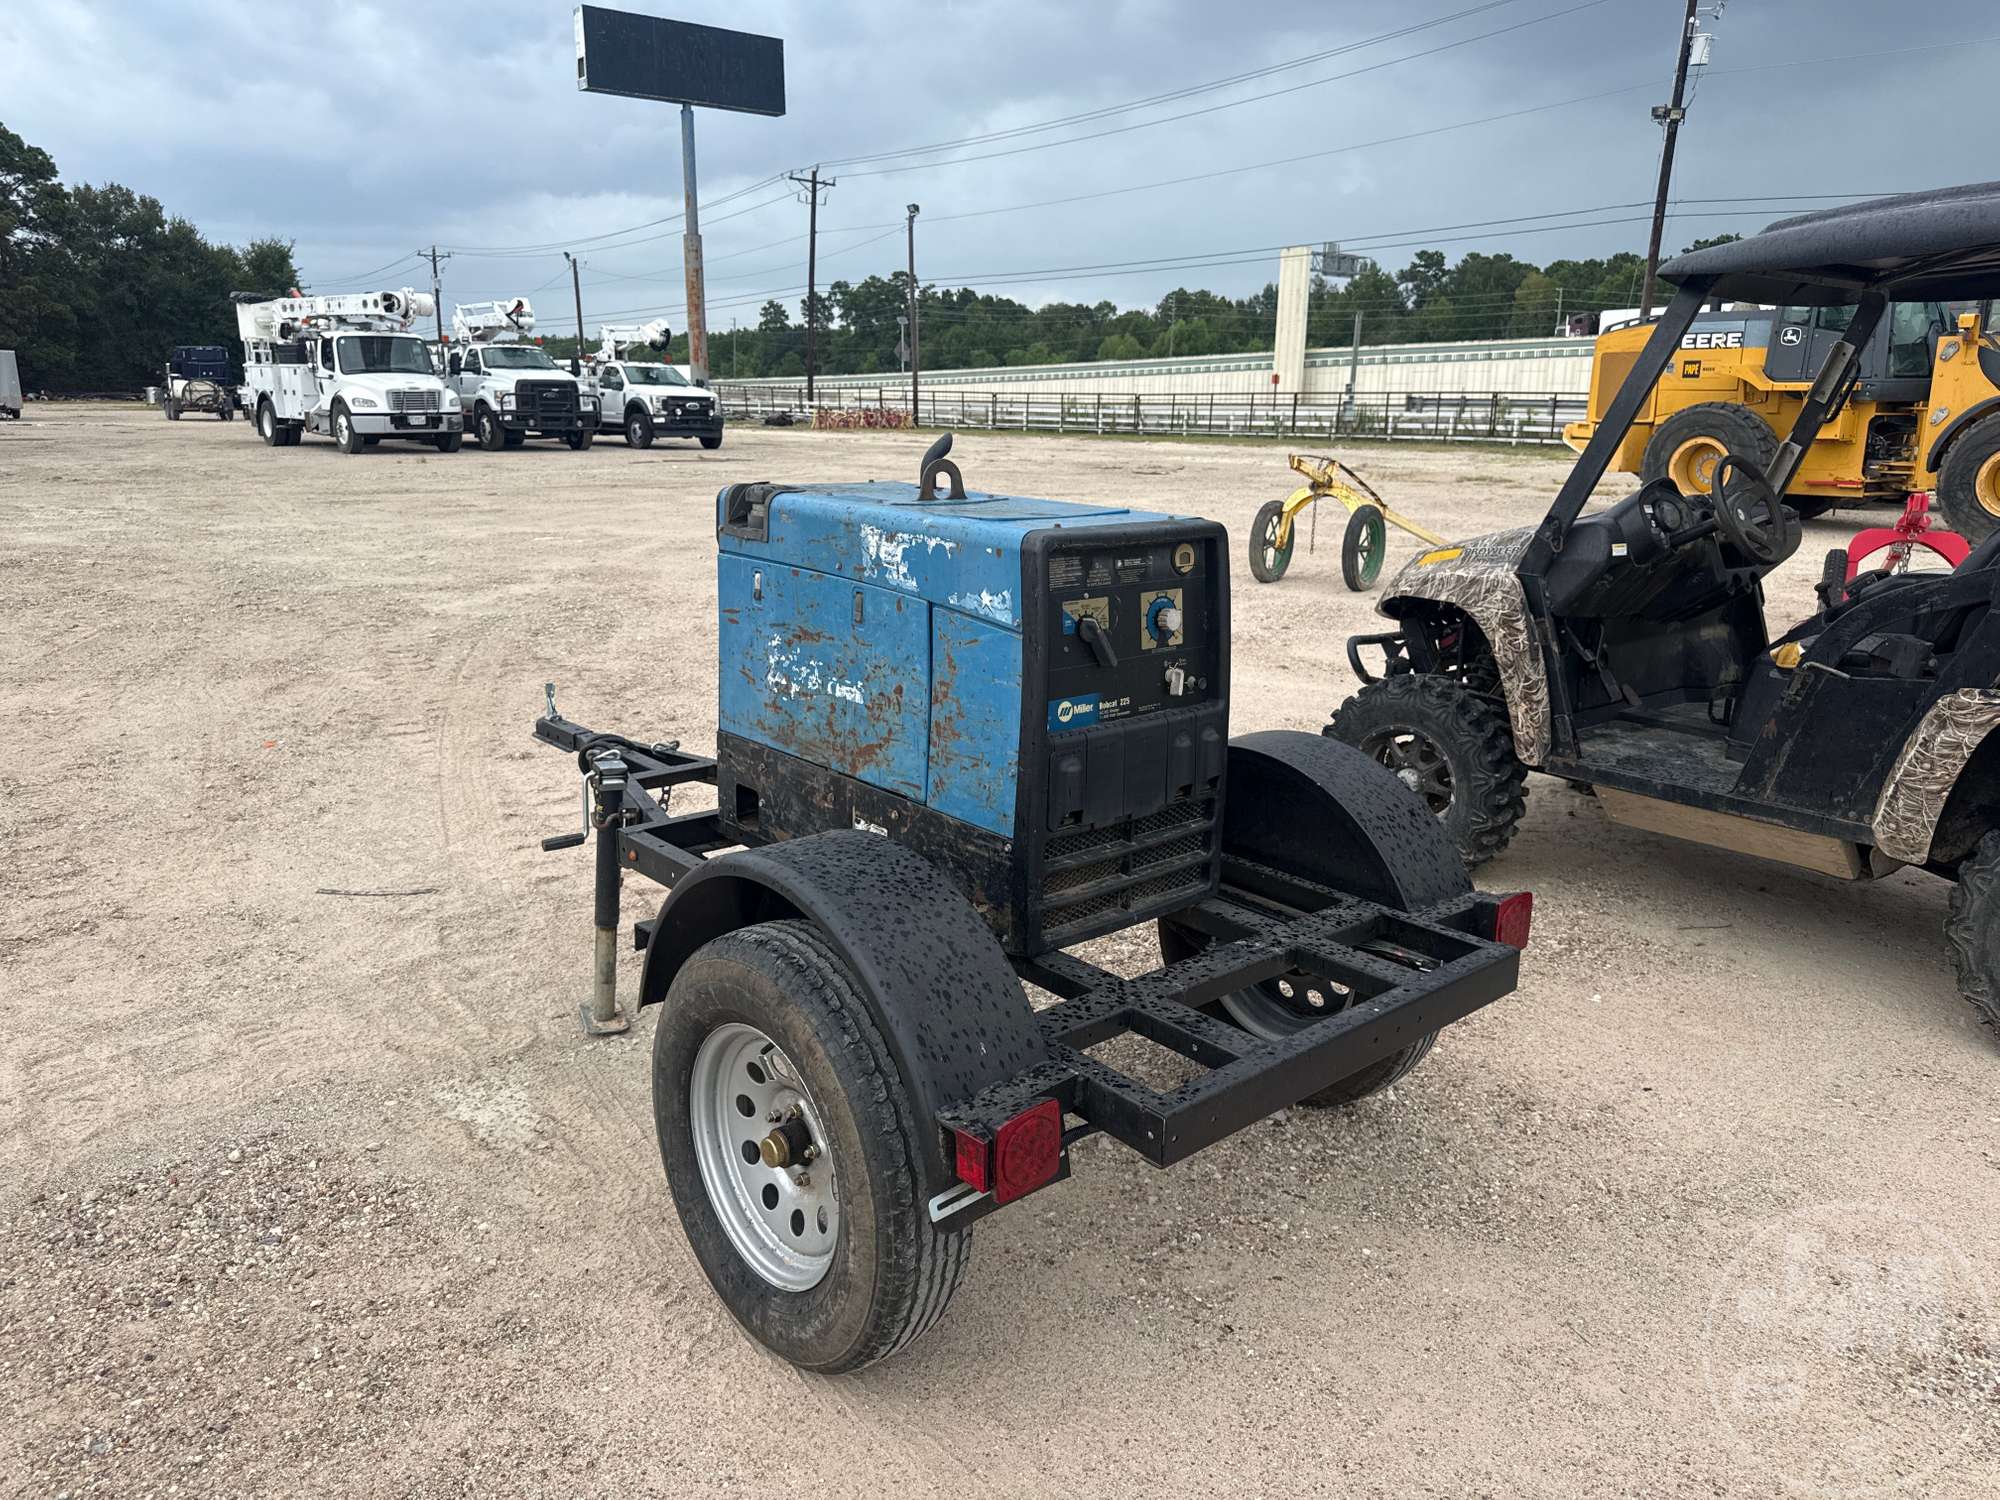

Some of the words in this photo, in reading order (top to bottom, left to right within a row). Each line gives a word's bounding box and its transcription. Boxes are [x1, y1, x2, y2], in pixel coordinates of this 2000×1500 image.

[1681, 332, 1742, 349] EERE
[1464, 546, 1519, 557] PROWLER
[1073, 703, 1093, 715] Miller
[1099, 699, 1118, 710] Bobcat
